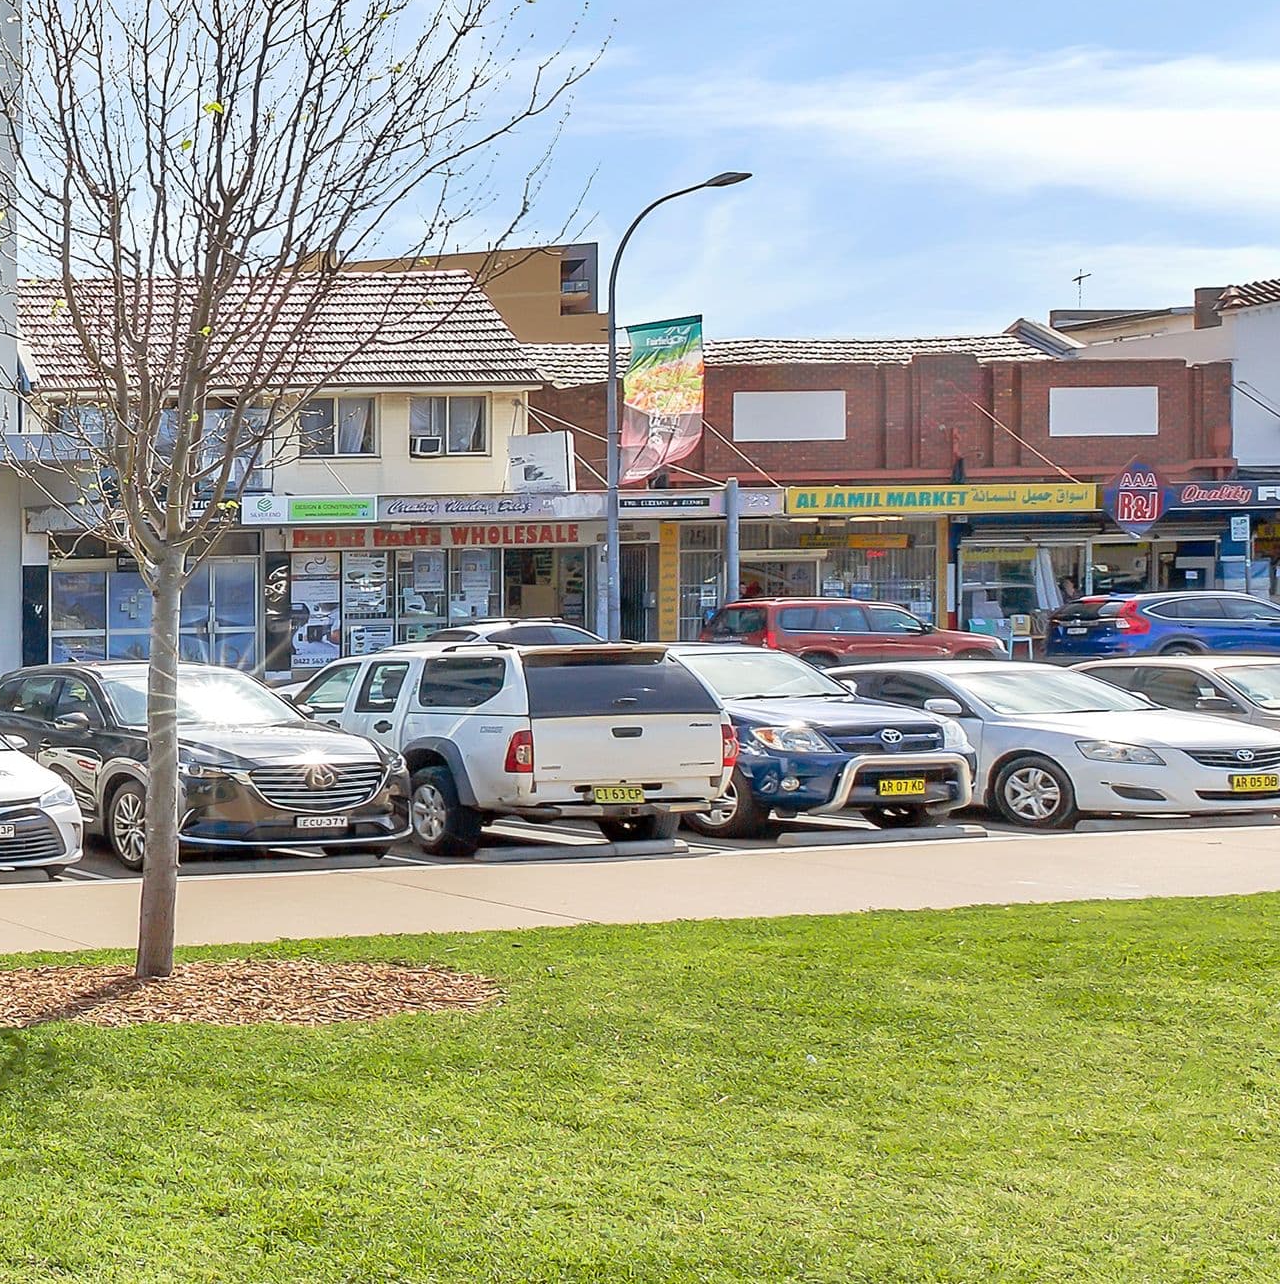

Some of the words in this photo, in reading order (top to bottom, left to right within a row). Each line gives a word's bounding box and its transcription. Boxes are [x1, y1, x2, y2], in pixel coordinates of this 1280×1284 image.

[1120, 472, 1158, 487] AAA
[746, 493, 770, 507] 23
[796, 492, 819, 508] AL
[824, 491, 883, 508] JAMIL
[886, 490, 969, 507] MARKET
[1181, 484, 1253, 503] Quality
[1118, 491, 1158, 521] R&J
[450, 523, 579, 545] WHOLESALE
[881, 781, 893, 792] AR
[896, 781, 908, 792] 07
[911, 780, 924, 791] KD
[1236, 777, 1247, 788] AR
[1250, 777, 1262, 787] 05
[1264, 776, 1277, 787] DB
[595, 788, 608, 799] CI
[612, 788, 626, 799] 63
[628, 788, 641, 799] CP
